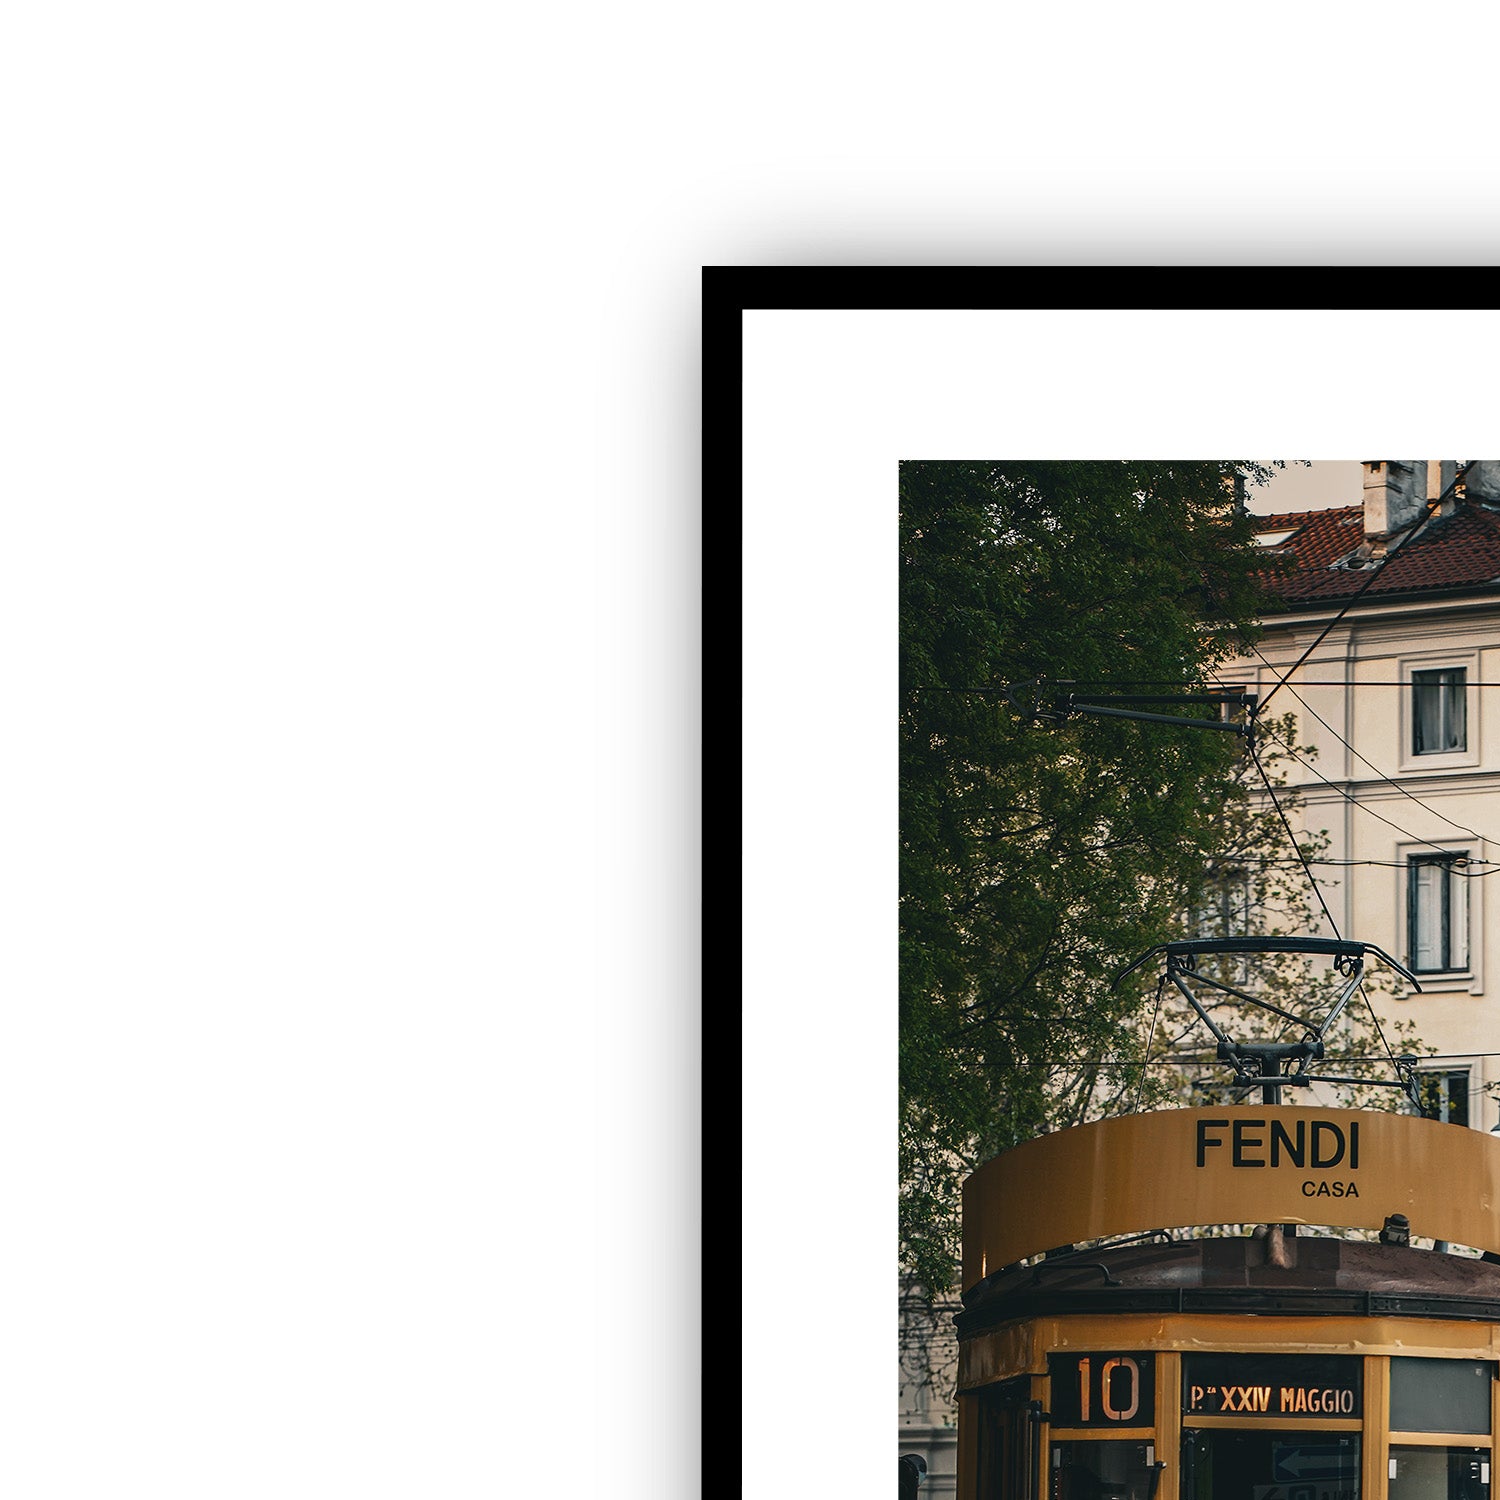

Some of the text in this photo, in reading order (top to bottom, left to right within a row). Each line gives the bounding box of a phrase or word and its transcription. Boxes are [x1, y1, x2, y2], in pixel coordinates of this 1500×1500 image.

[1196, 1119, 1360, 1170] FENDI
[1301, 1180, 1360, 1198] CASA
[1078, 1356, 1140, 1422] 10
[1219, 1386, 1272, 1412] XXIV
[1280, 1387, 1354, 1413] MAGGIO
